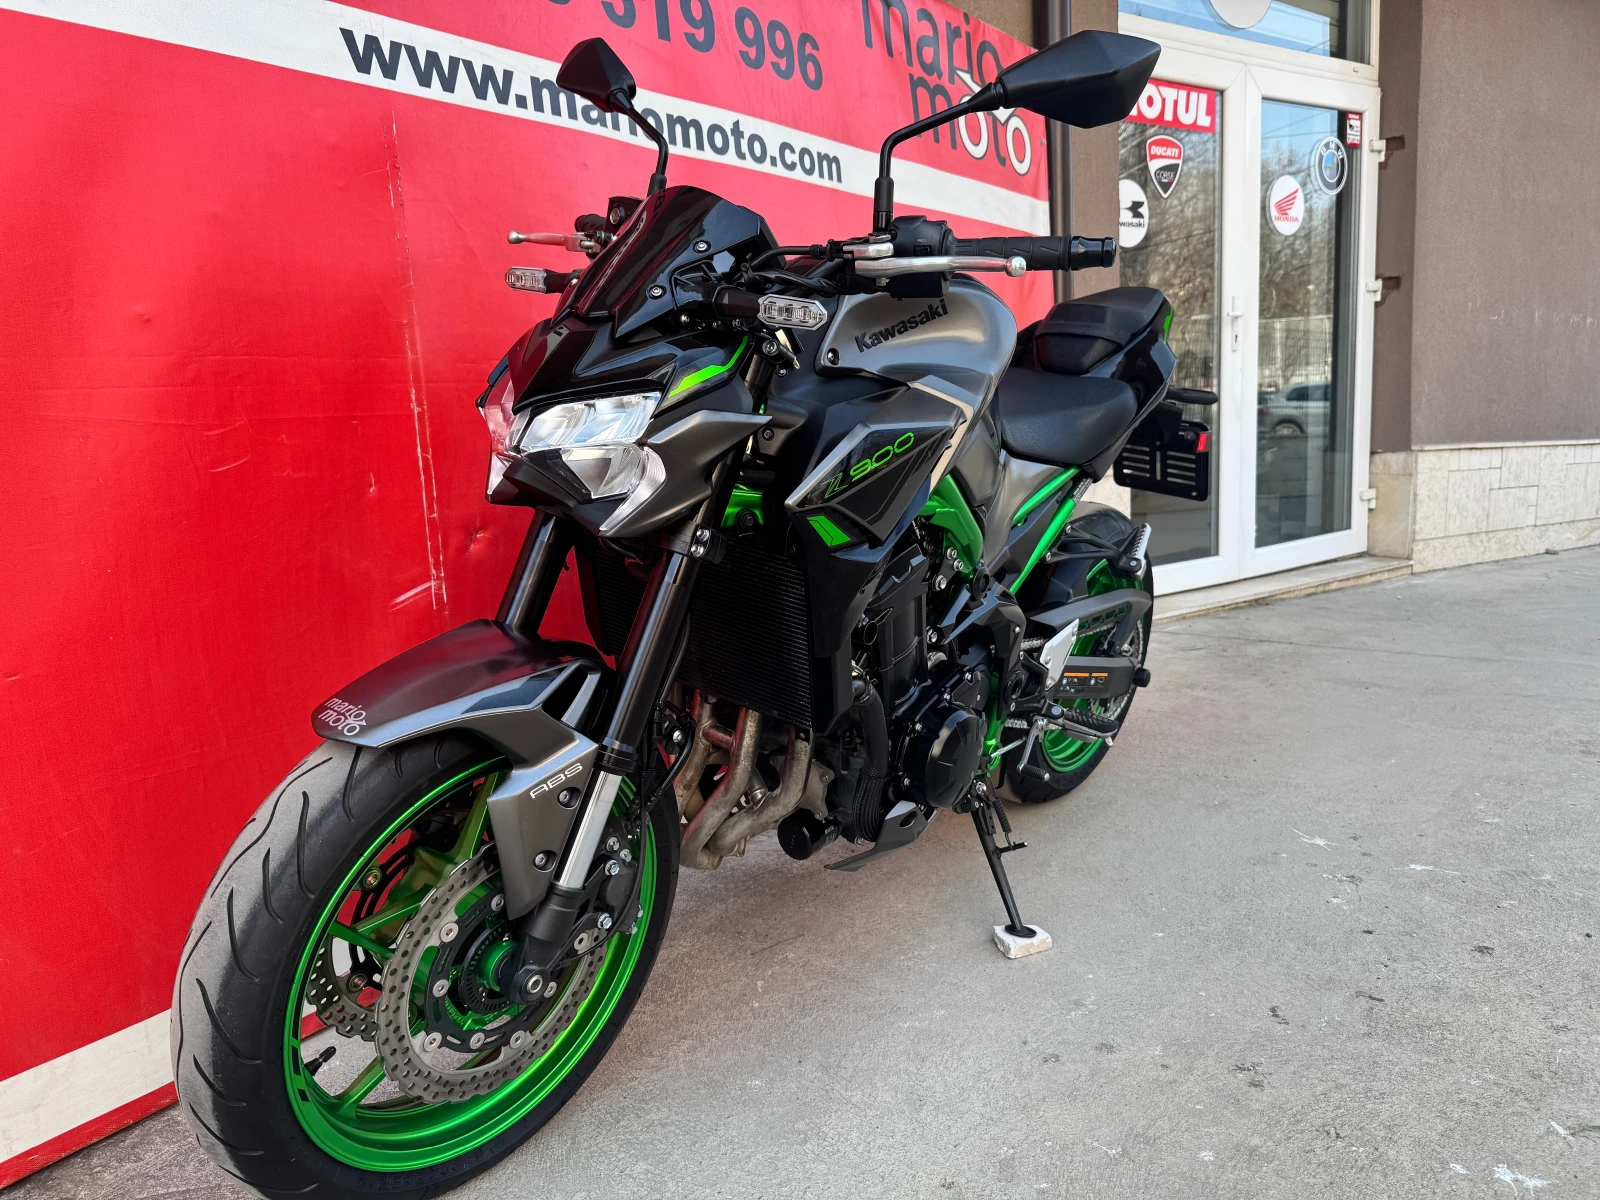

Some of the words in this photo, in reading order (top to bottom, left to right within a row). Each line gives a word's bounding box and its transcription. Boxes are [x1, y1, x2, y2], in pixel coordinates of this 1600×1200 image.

[734, 6, 824, 91] 996
[1129, 82, 1212, 128] OTUL
[908, 73, 1032, 177] moto
[1150, 145, 1179, 157] DUCATI
[1320, 141, 1344, 160] BMW
[1155, 170, 1175, 180] CORSE
[854, 300, 949, 353] Kawasaki
[317, 709, 361, 736] moto
[324, 697, 366, 721] mario
[529, 762, 583, 800] ABS
